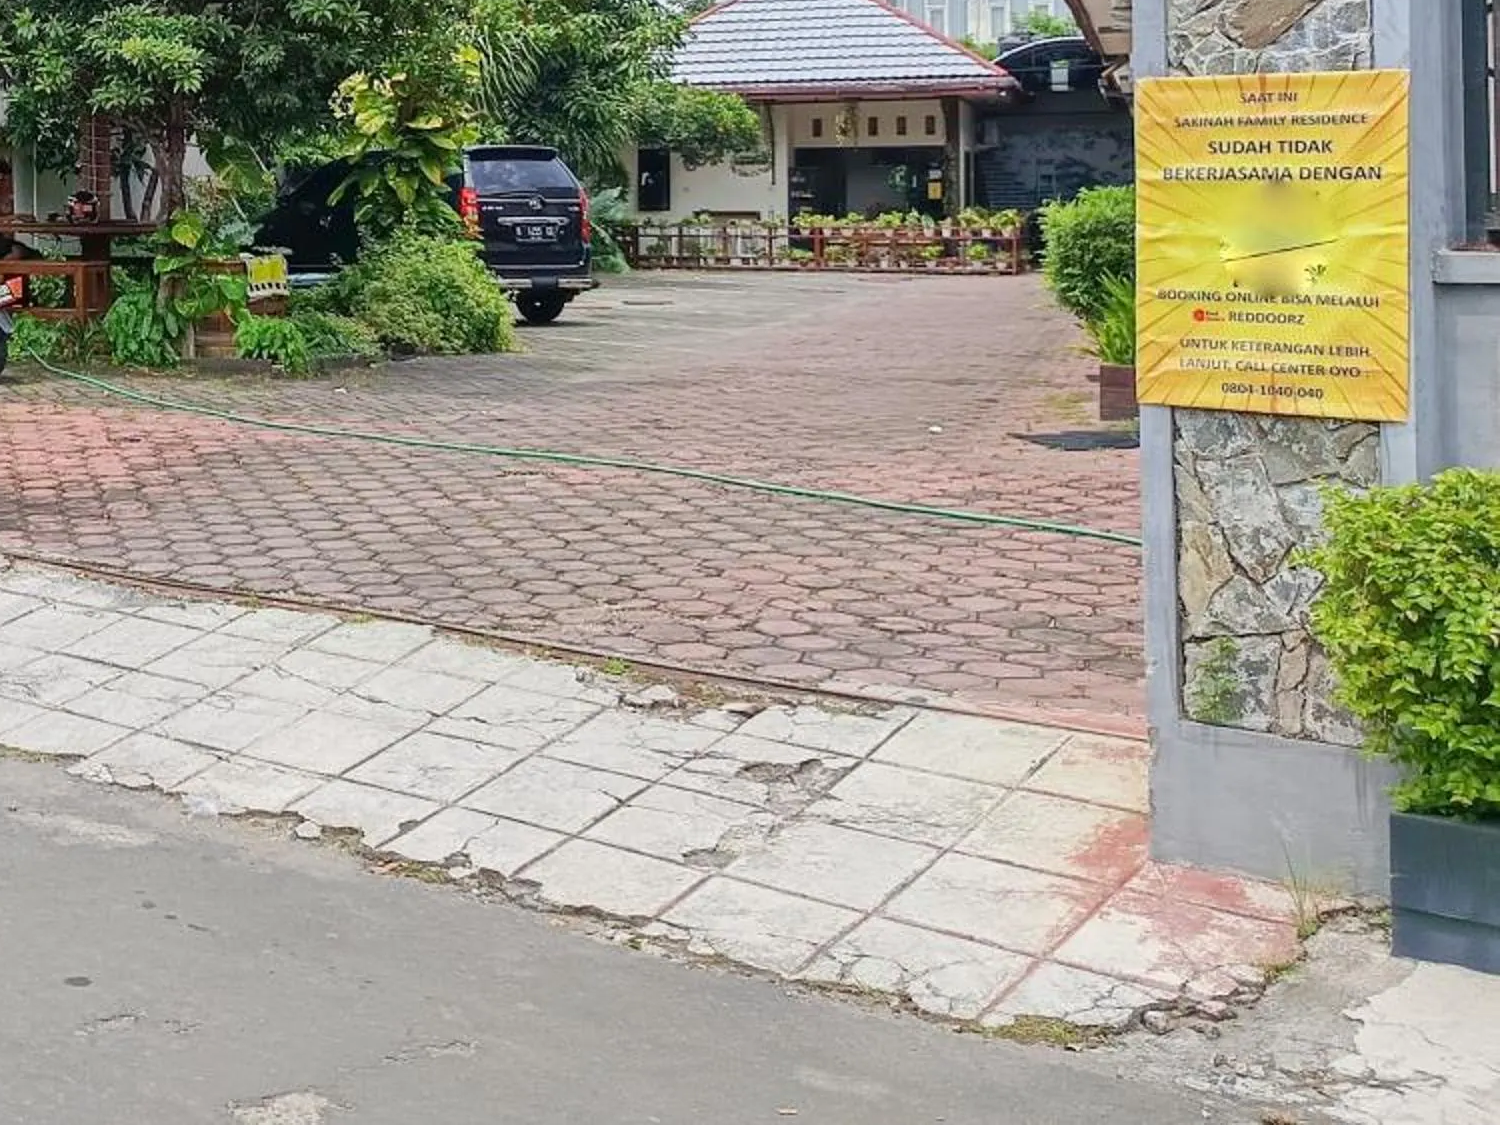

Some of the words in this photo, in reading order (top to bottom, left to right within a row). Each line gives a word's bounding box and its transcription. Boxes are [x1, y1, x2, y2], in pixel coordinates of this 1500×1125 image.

[1239, 91, 1274, 104] SAAT
[1277, 91, 1298, 103] INI
[1175, 115, 1234, 129] SAKINAH
[1237, 115, 1287, 127] FAMILY
[1291, 113, 1369, 125] RESIDENCE
[1208, 140, 1271, 155] SUDAH
[1277, 139, 1333, 154] TIDAK
[1163, 167, 1293, 182] BEKERJASAMA
[1299, 166, 1382, 181] DENGAN
[1157, 290, 1222, 303] BOOKING
[1226, 291, 1277, 304] ONLINE
[1281, 294, 1312, 306] BISA
[1316, 295, 1380, 308] MELALUI
[1229, 311, 1305, 325] REDDOORZ
[1180, 339, 1230, 352] UNTUK
[1232, 340, 1325, 357] KETERANGAN
[1329, 345, 1370, 358] LEBIH
[1235, 360, 1267, 373] CALL
[1271, 362, 1325, 376] CENTER
[1329, 365, 1361, 378] OYO
